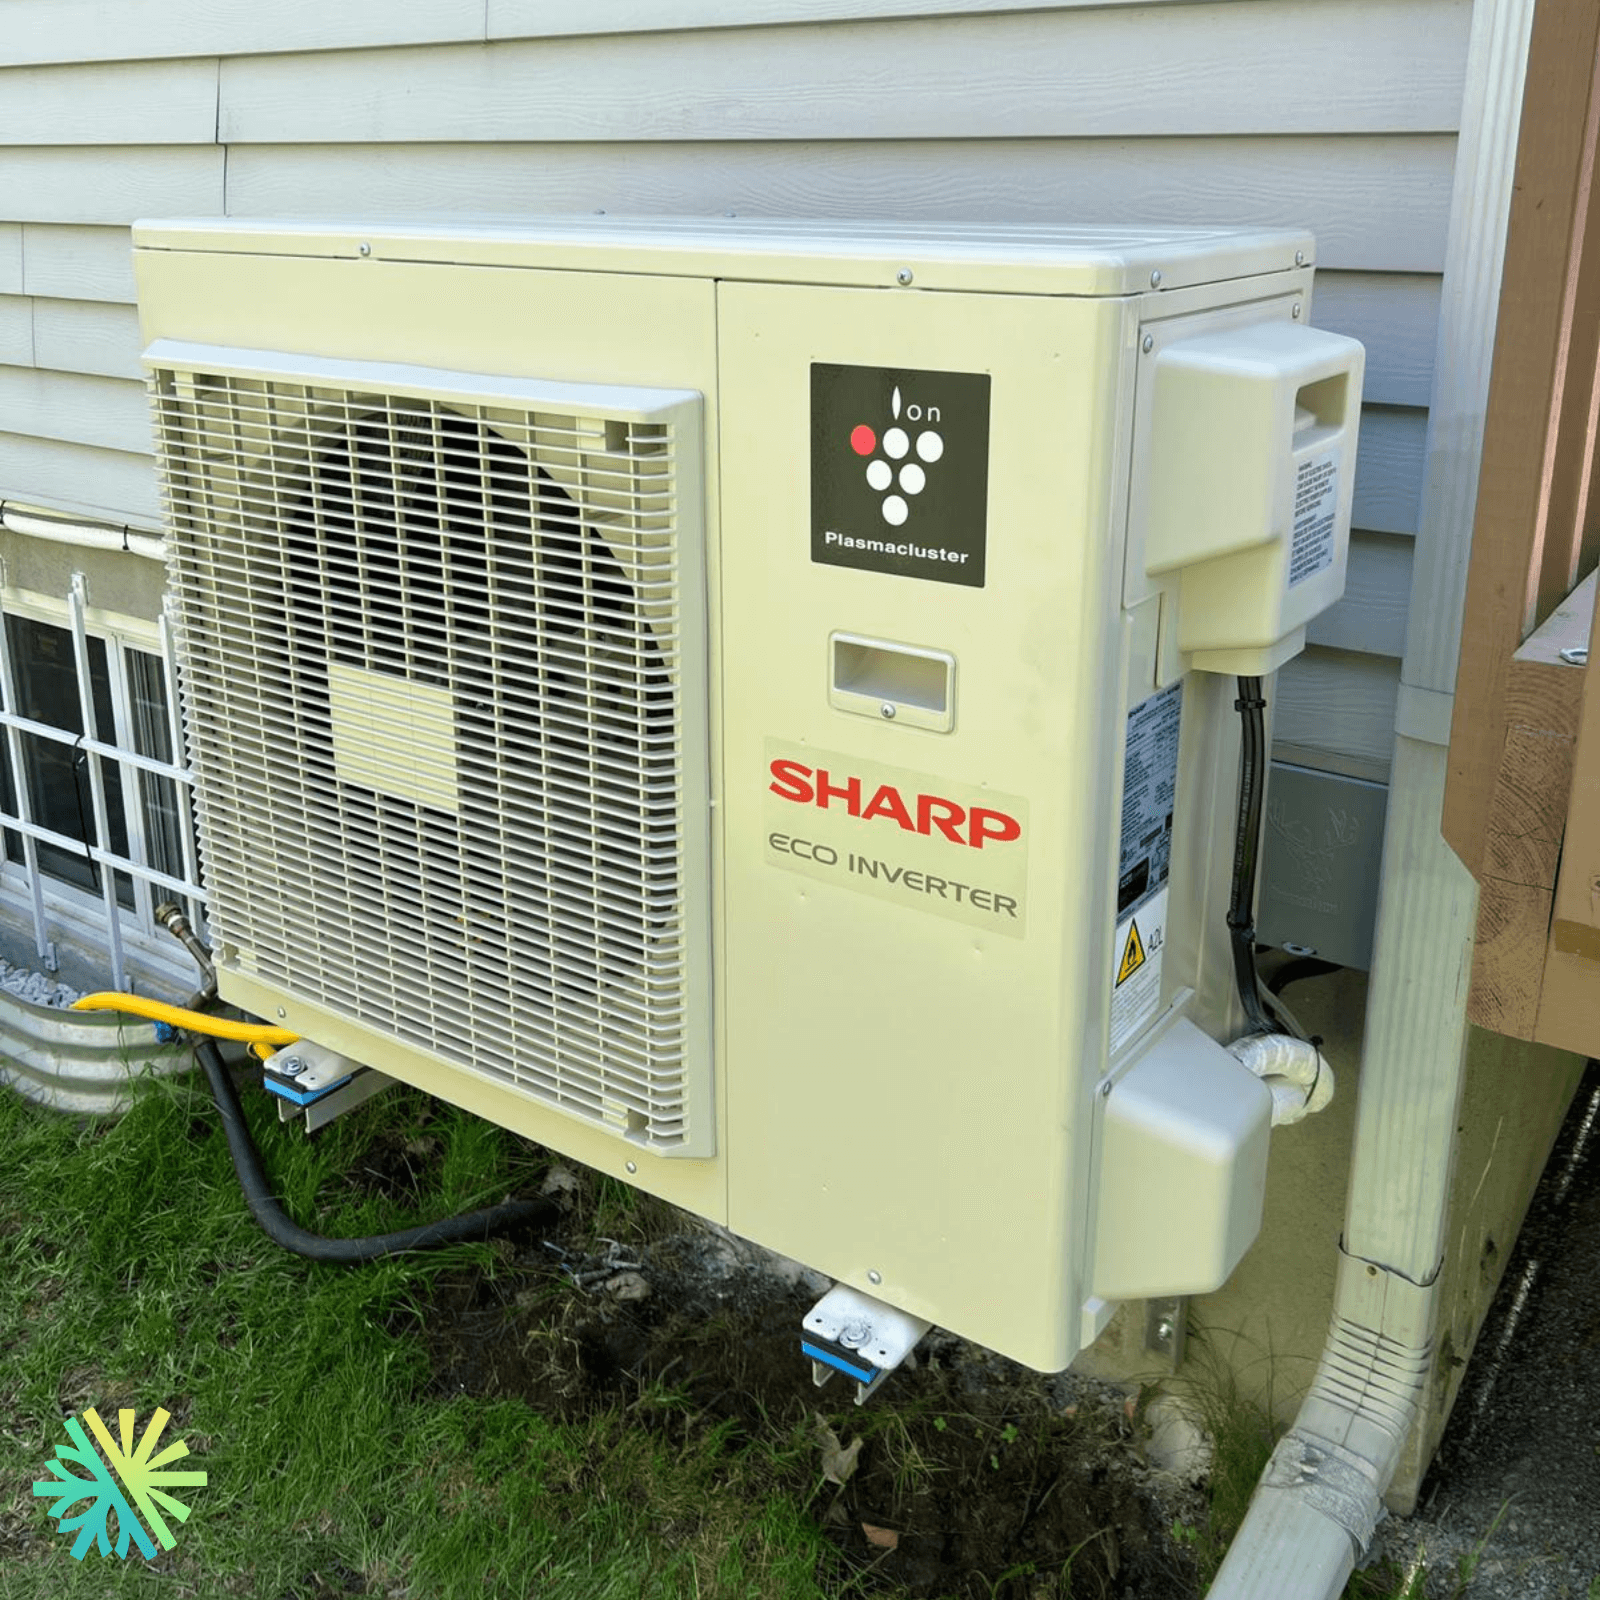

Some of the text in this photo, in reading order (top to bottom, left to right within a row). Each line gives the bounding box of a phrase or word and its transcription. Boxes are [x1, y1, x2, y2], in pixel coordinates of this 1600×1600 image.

[891, 385, 941, 422] Ion
[825, 531, 969, 564] Plasmacluster
[768, 758, 1021, 850] SHARP
[769, 832, 1018, 918] ECO INVERTER
[1147, 925, 1163, 956] A2L
